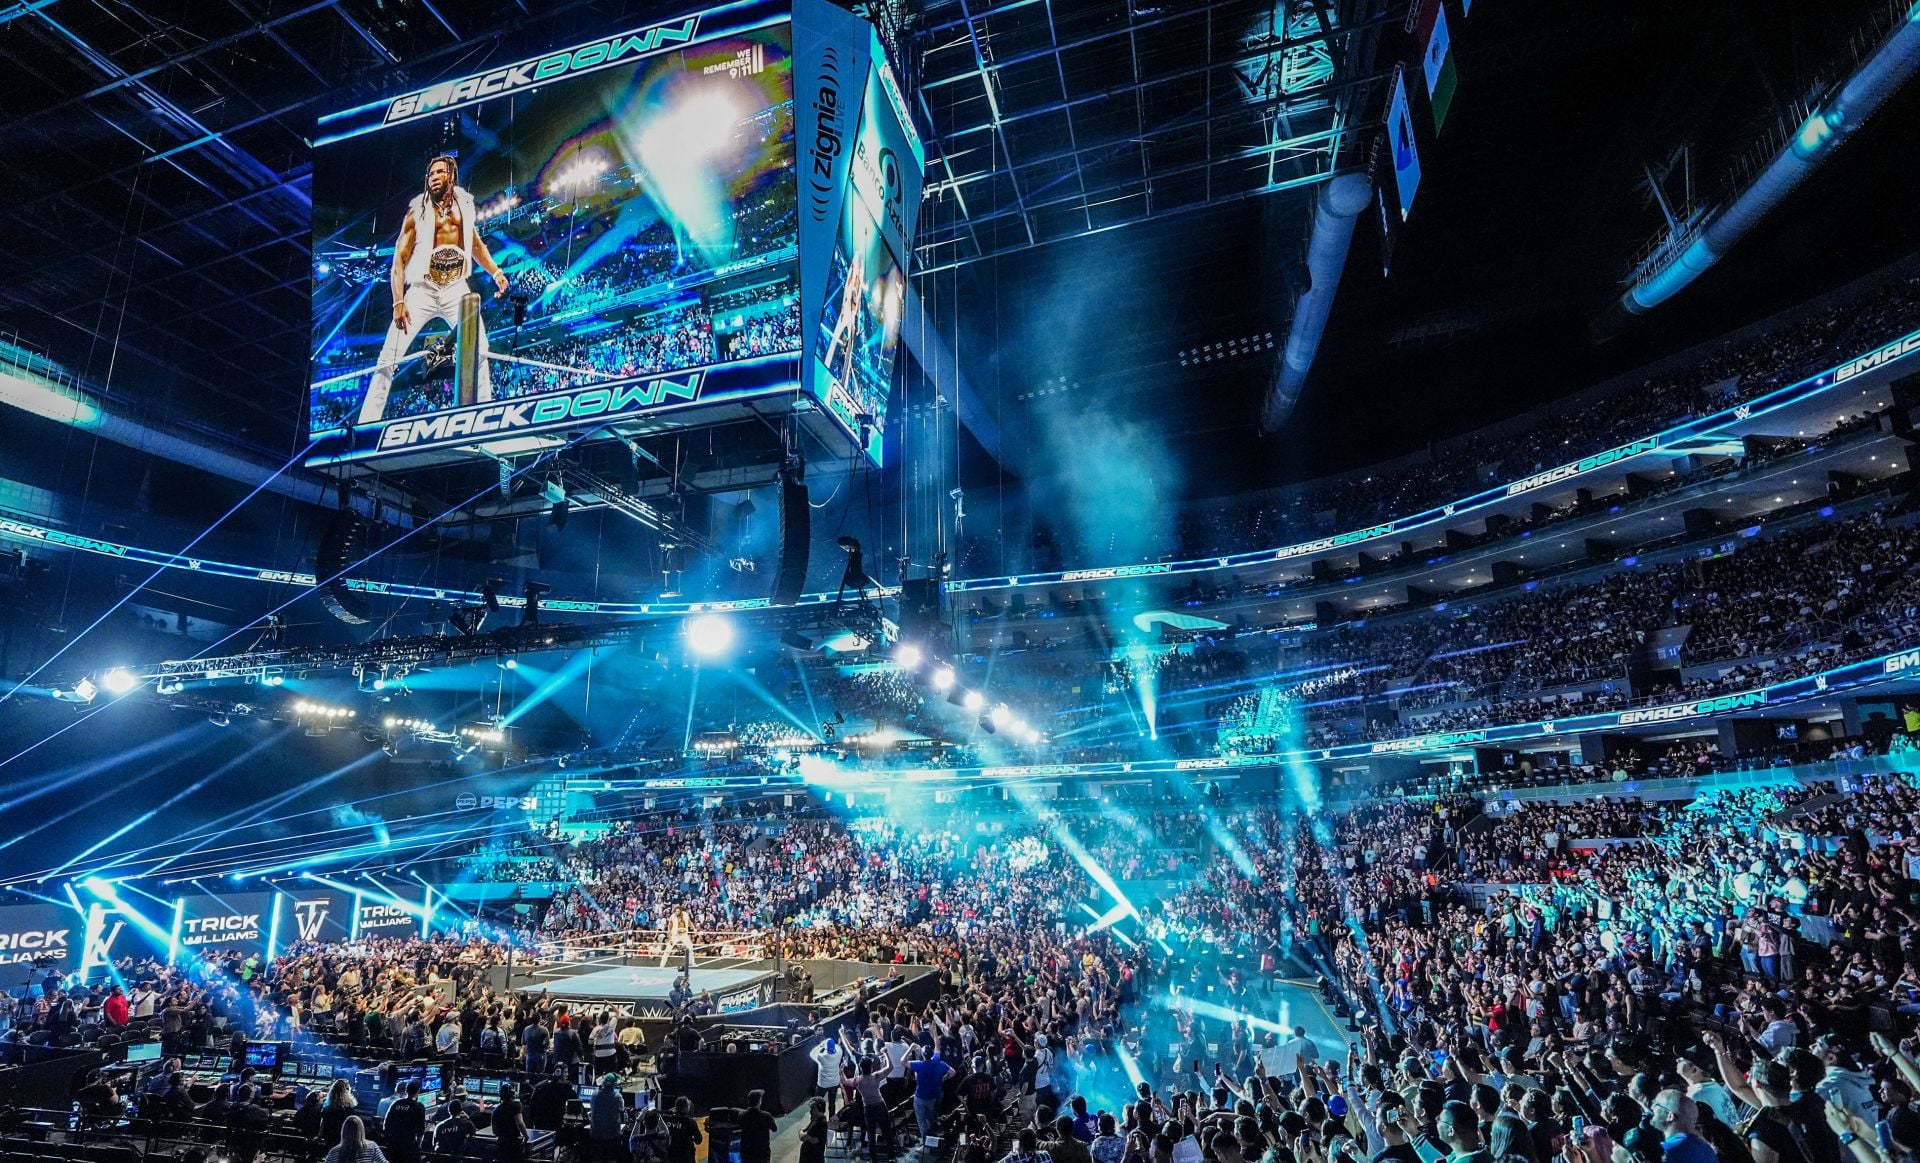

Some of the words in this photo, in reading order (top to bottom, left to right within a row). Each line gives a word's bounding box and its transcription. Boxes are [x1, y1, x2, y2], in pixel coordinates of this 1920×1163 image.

[736, 48, 751, 58] WE
[388, 18, 695, 122] SMACKDOWN
[703, 56, 752, 76] REMEMBER
[810, 86, 842, 180] zignia
[857, 140, 885, 201] Banco
[320, 378, 361, 395] PEPSI
[382, 373, 700, 448] SMACKDOWN
[1509, 437, 1656, 495] SMACKDOWN
[1277, 523, 1393, 559] SMACKDOWN
[1062, 563, 1171, 582] SMACKDOWN
[1619, 691, 1766, 724] SMACKDOWN
[1372, 731, 1486, 753] SMACKDOWN
[1176, 755, 1280, 769] SMACKDOWN
[480, 795, 538, 811] PEPSI
[184, 914, 260, 933] TRICK
[360, 916, 412, 929] WILLIAMS
[183, 930, 259, 946] WILLIAMS
